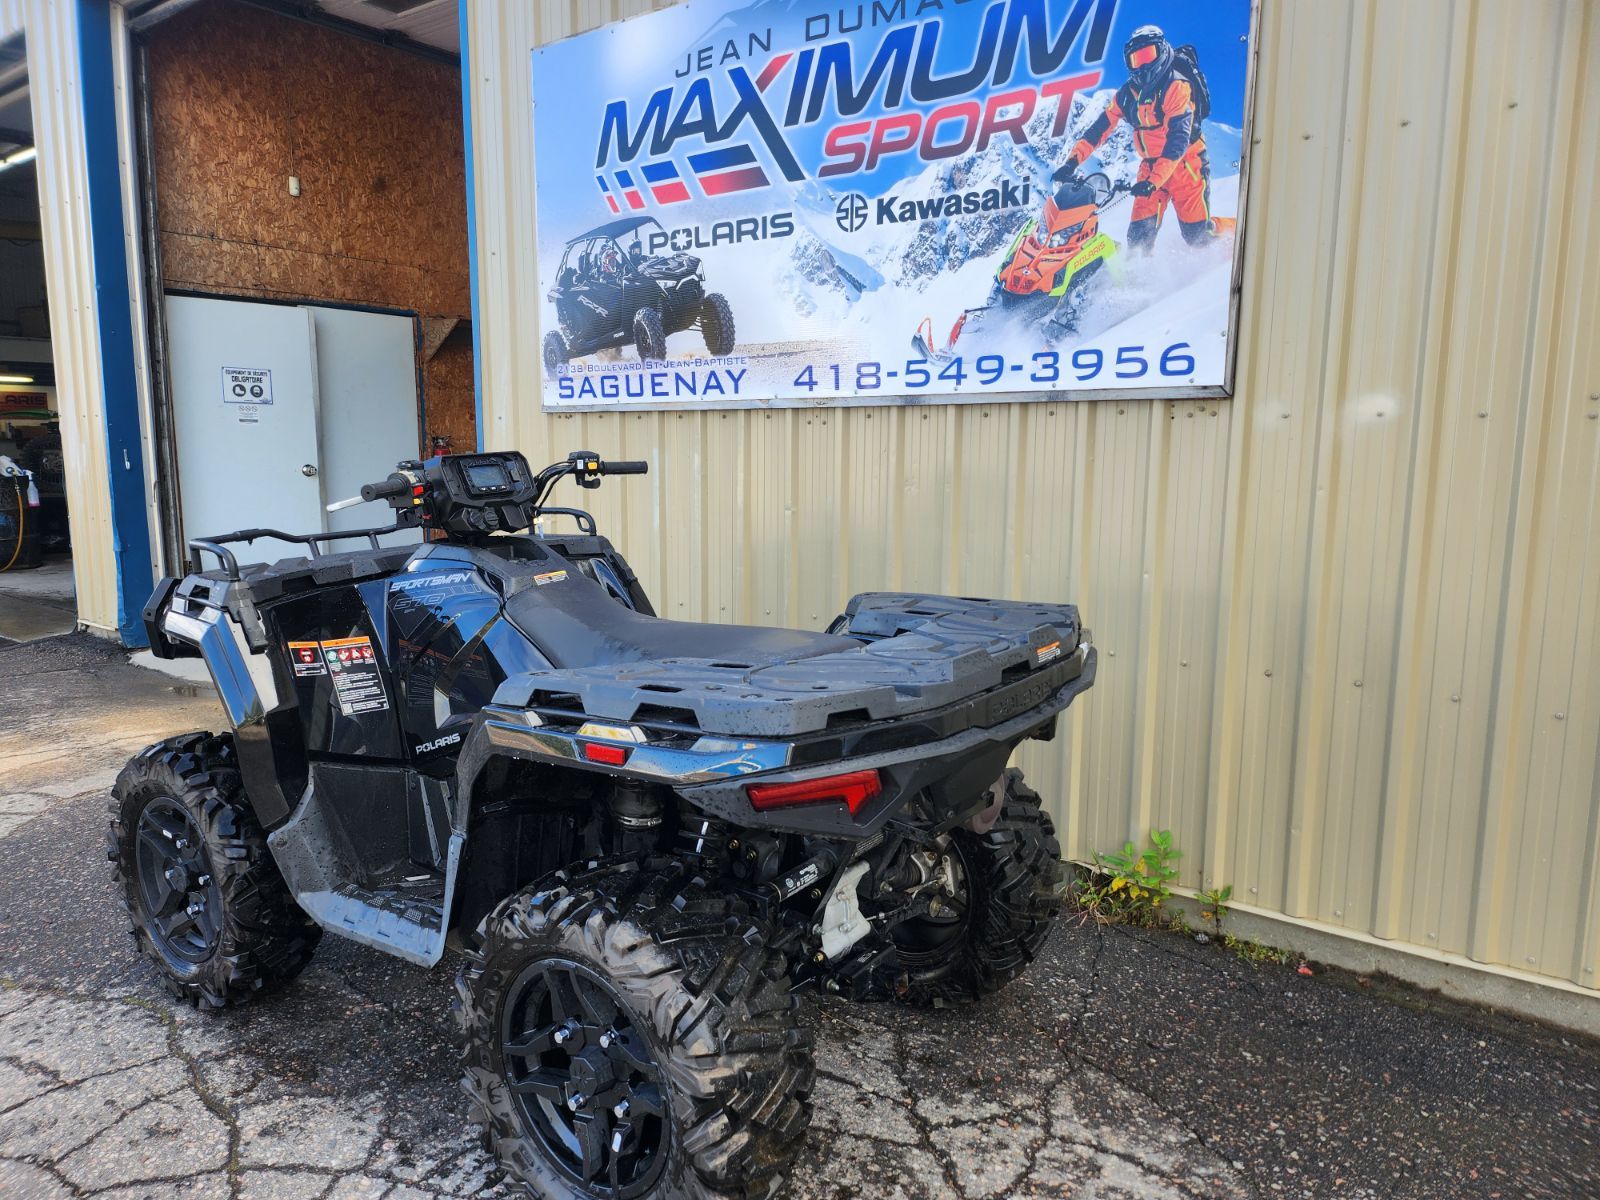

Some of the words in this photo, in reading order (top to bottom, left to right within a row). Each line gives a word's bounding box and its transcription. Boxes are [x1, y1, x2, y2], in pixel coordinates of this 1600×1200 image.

[674, 27, 772, 79] JEAN
[804, 0, 978, 43] DUMA
[595, 0, 1118, 183] MAXIMUM
[817, 71, 1102, 178] SPORT
[876, 175, 1030, 226] Kawasaki
[648, 211, 795, 255] POLARIS
[1073, 241, 1105, 270] POLARIS
[557, 364, 583, 374] 2138
[558, 368, 748, 399] SAGUENAY
[793, 342, 1196, 392] 418-549-3956
[389, 572, 472, 592] SPORTSMAN
[415, 732, 461, 756] POLARIS
